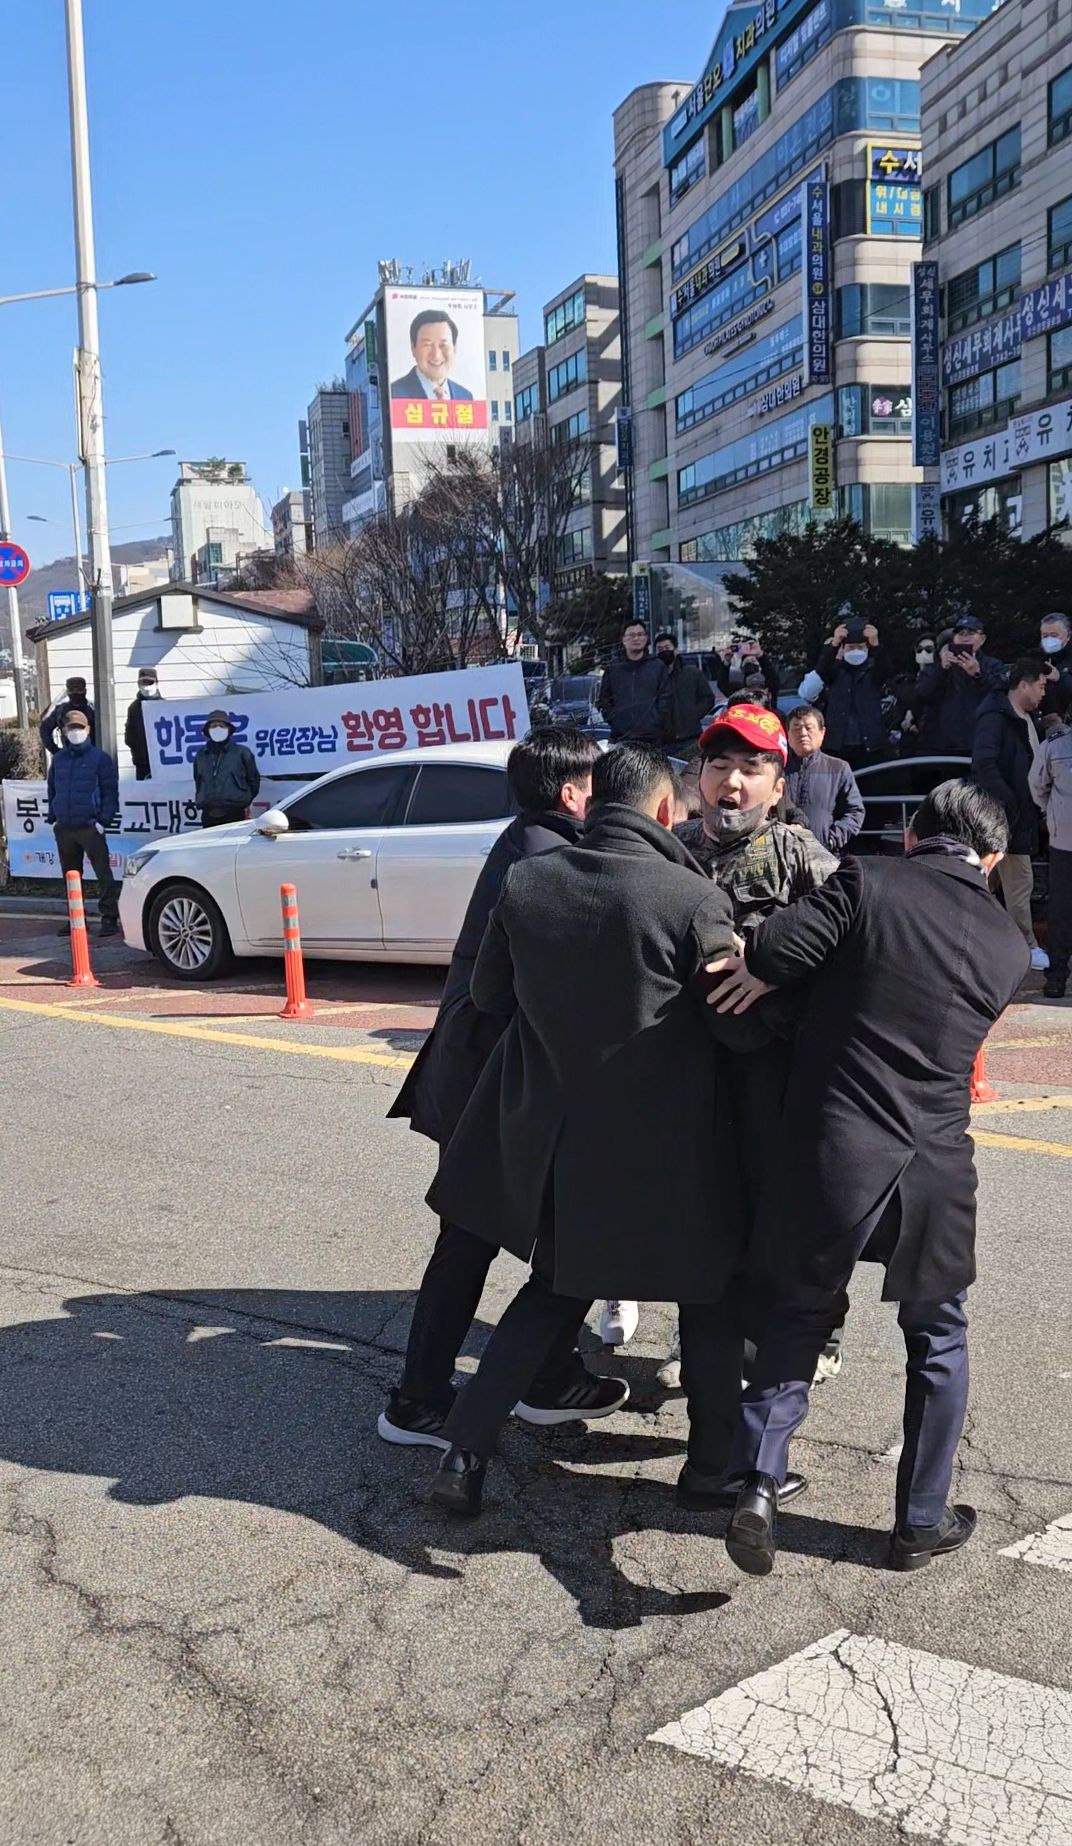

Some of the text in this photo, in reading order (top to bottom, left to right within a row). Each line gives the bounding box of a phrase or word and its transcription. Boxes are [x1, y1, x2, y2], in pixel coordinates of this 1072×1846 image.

[811, 186, 824, 280] 수서울내과의원
[919, 279, 935, 363] 세무회계사무소
[1022, 275, 1072, 326] 성신세
[405, 403, 474, 425] 심규철
[813, 427, 830, 506] 안경공장
[255, 725, 338, 757] 위원장님
